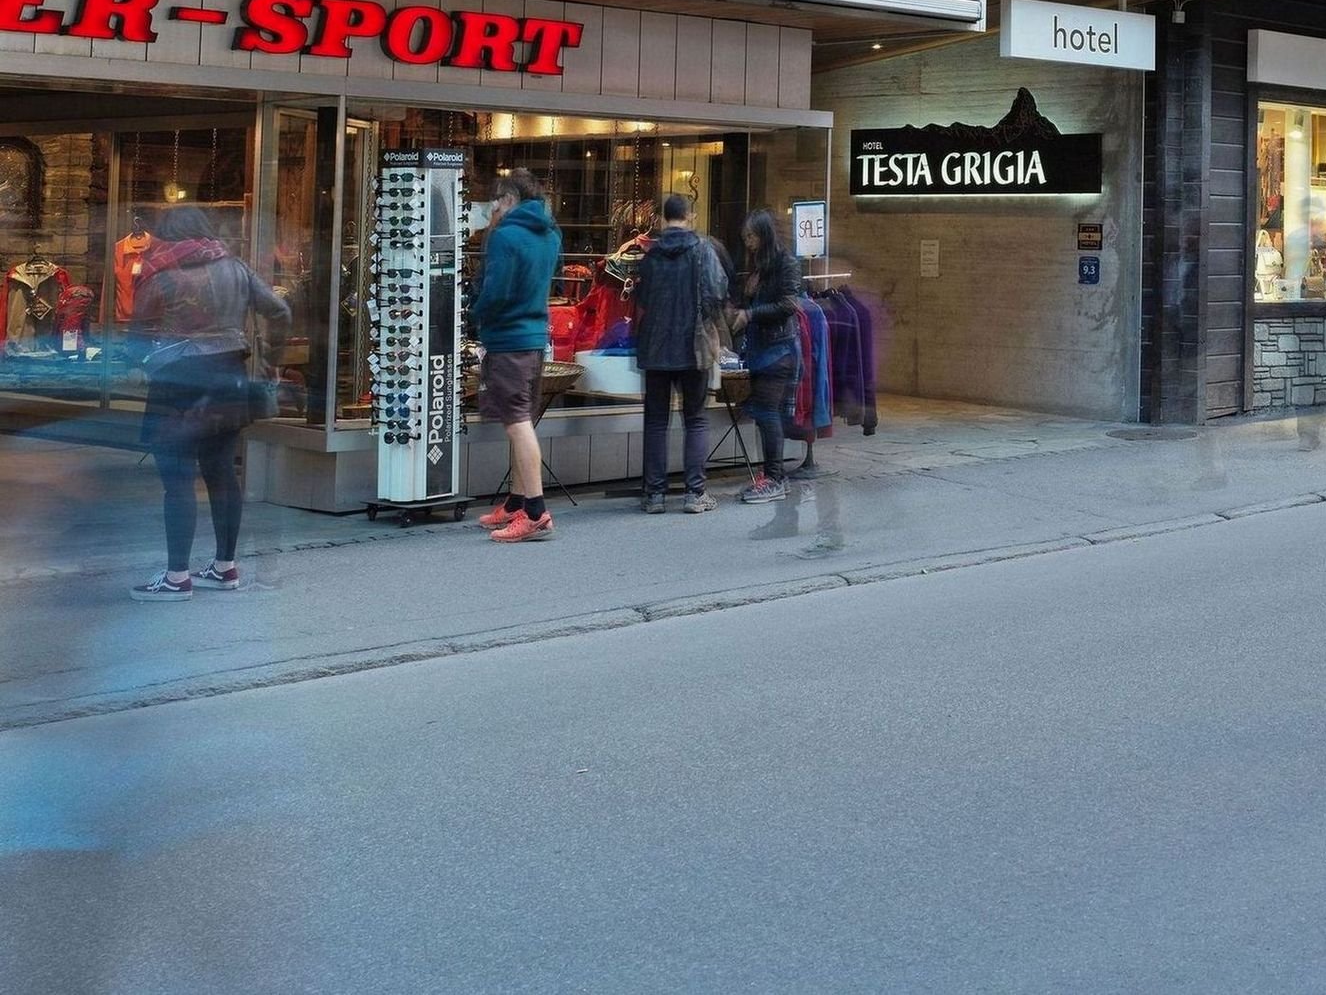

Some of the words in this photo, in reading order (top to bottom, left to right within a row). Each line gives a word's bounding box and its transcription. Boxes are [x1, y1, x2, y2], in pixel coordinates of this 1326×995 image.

[1053, 15, 1119, 54] hotel
[390, 151, 419, 161] Polaroid
[433, 152, 464, 162] Polaroid
[861, 141, 884, 150] HOTEL
[856, 153, 934, 186] TESTA
[941, 150, 1047, 186] GRIGIA
[799, 219, 823, 238] SALE
[428, 354, 445, 444] Polaroid
[444, 404, 453, 443] Polarized
